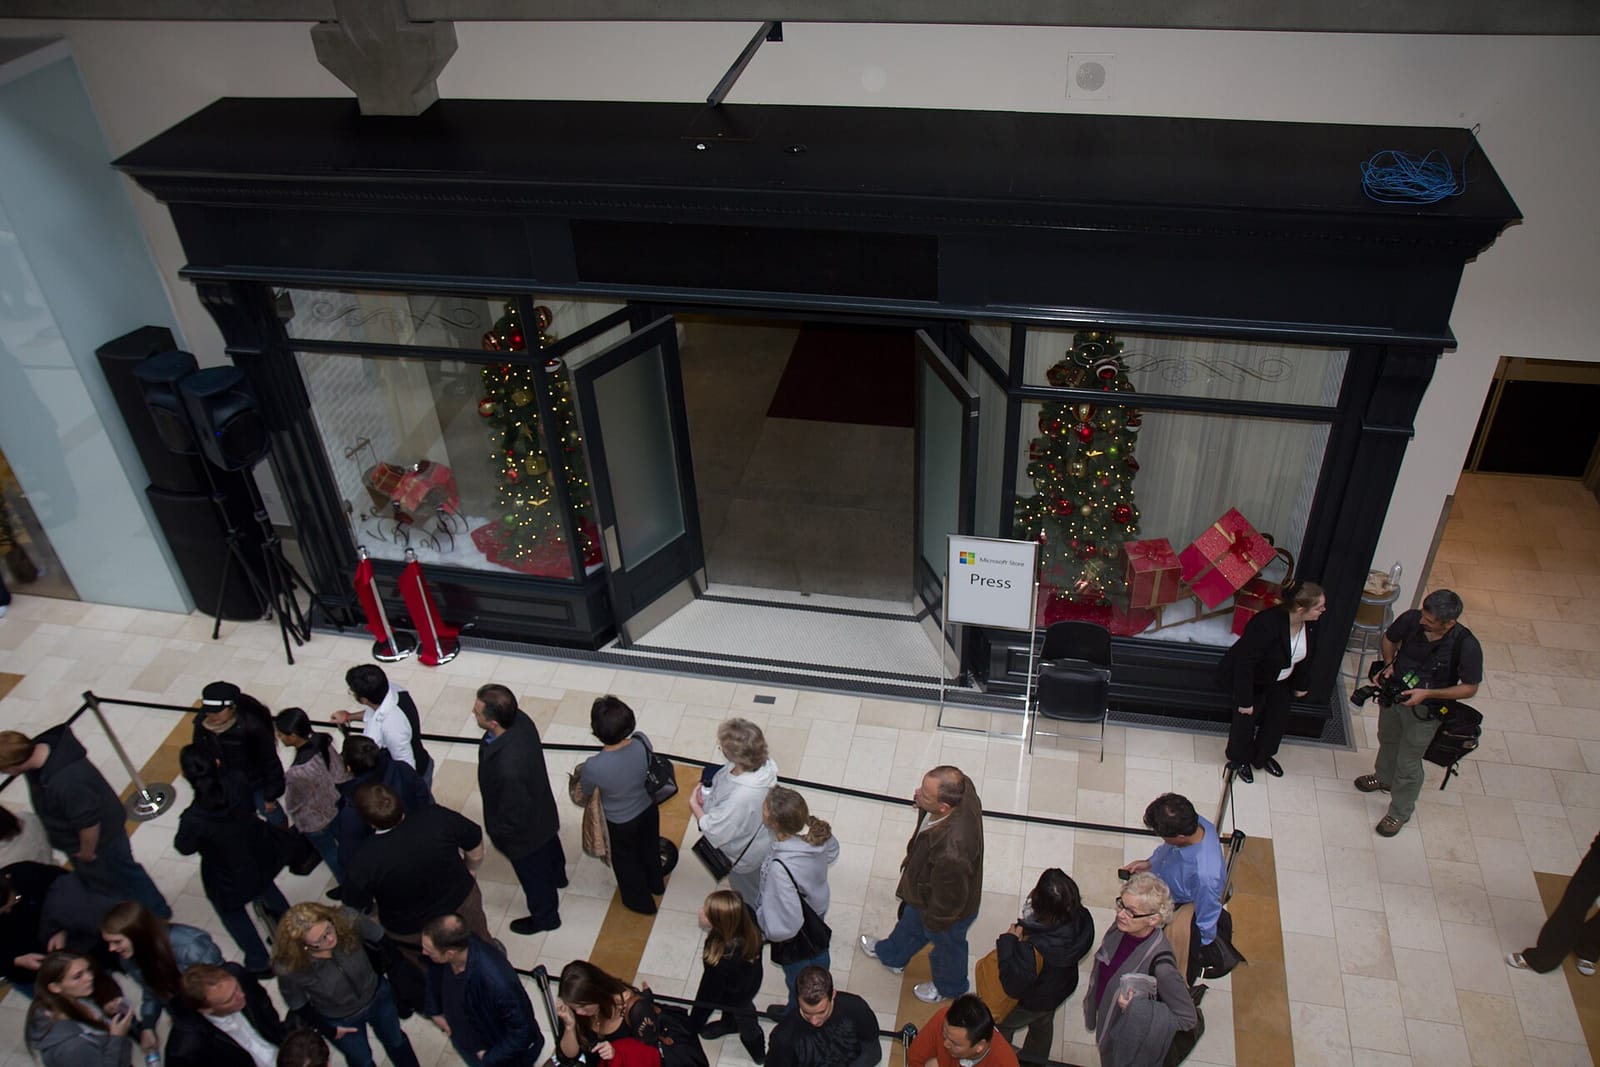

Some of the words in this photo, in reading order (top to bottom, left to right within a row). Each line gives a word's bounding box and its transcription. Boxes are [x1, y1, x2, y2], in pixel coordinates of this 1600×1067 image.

[979, 557, 1008, 565] Microsoft
[1009, 559, 1025, 567] Store
[970, 573, 1012, 590] Press
